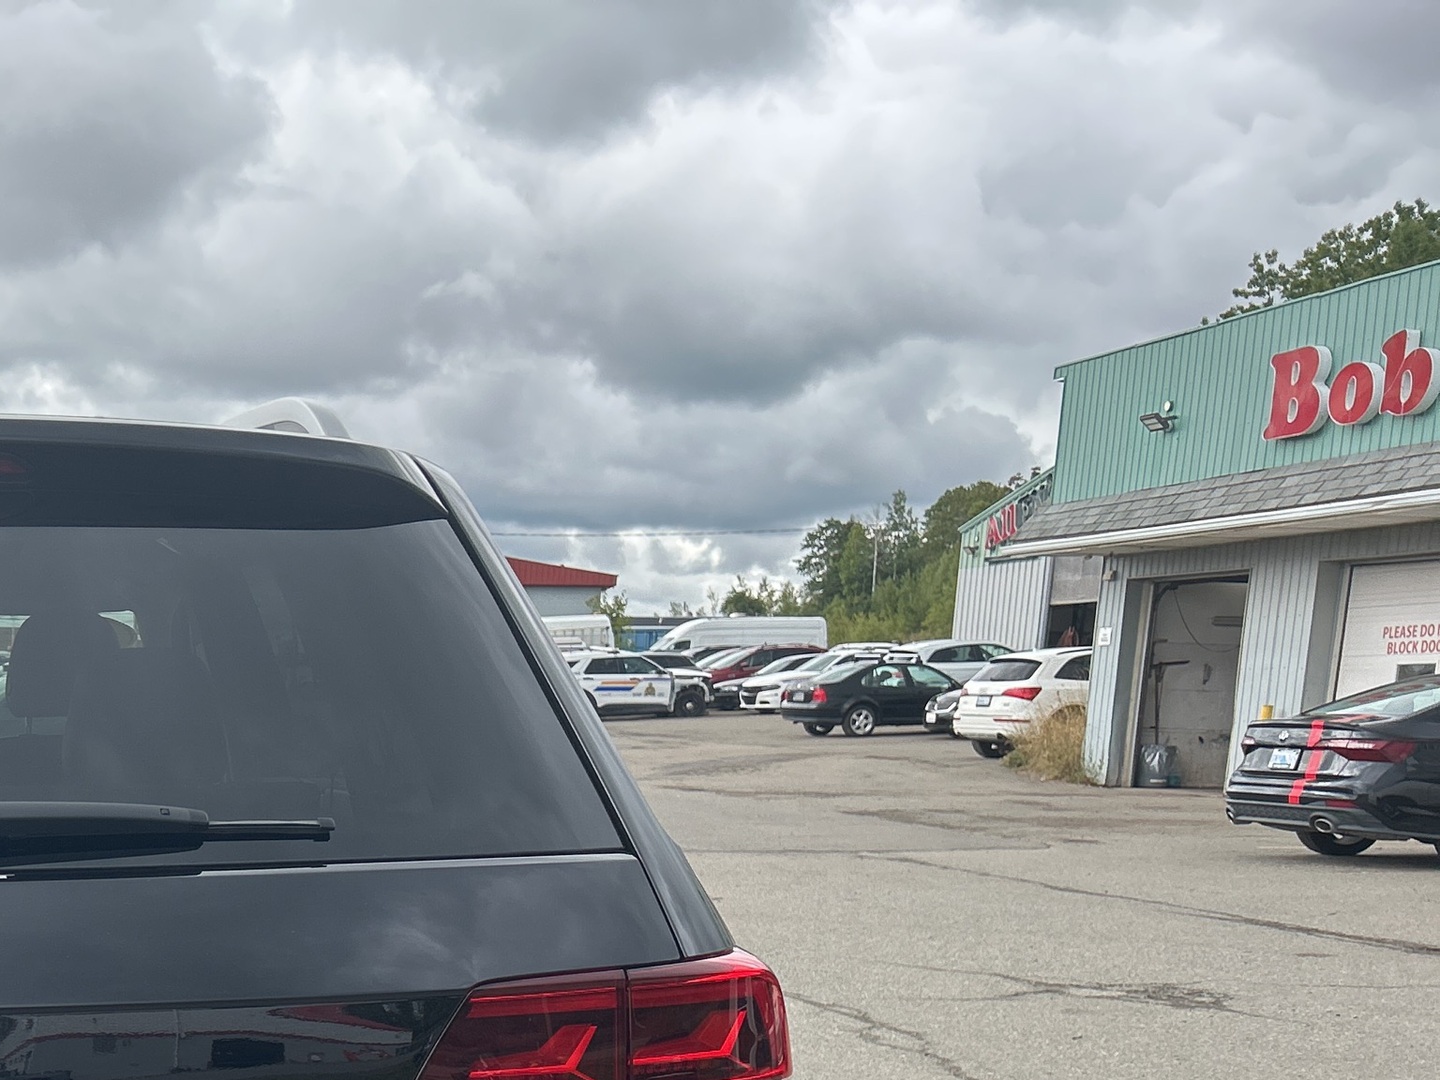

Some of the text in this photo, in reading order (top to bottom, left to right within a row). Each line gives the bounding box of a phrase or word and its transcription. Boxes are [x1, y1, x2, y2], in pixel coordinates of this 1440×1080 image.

[1262, 329, 1440, 441] Bob
[1382, 624, 1418, 639] PLEASE
[1420, 624, 1435, 637] DO
[1386, 641, 1419, 655] BLOCK
